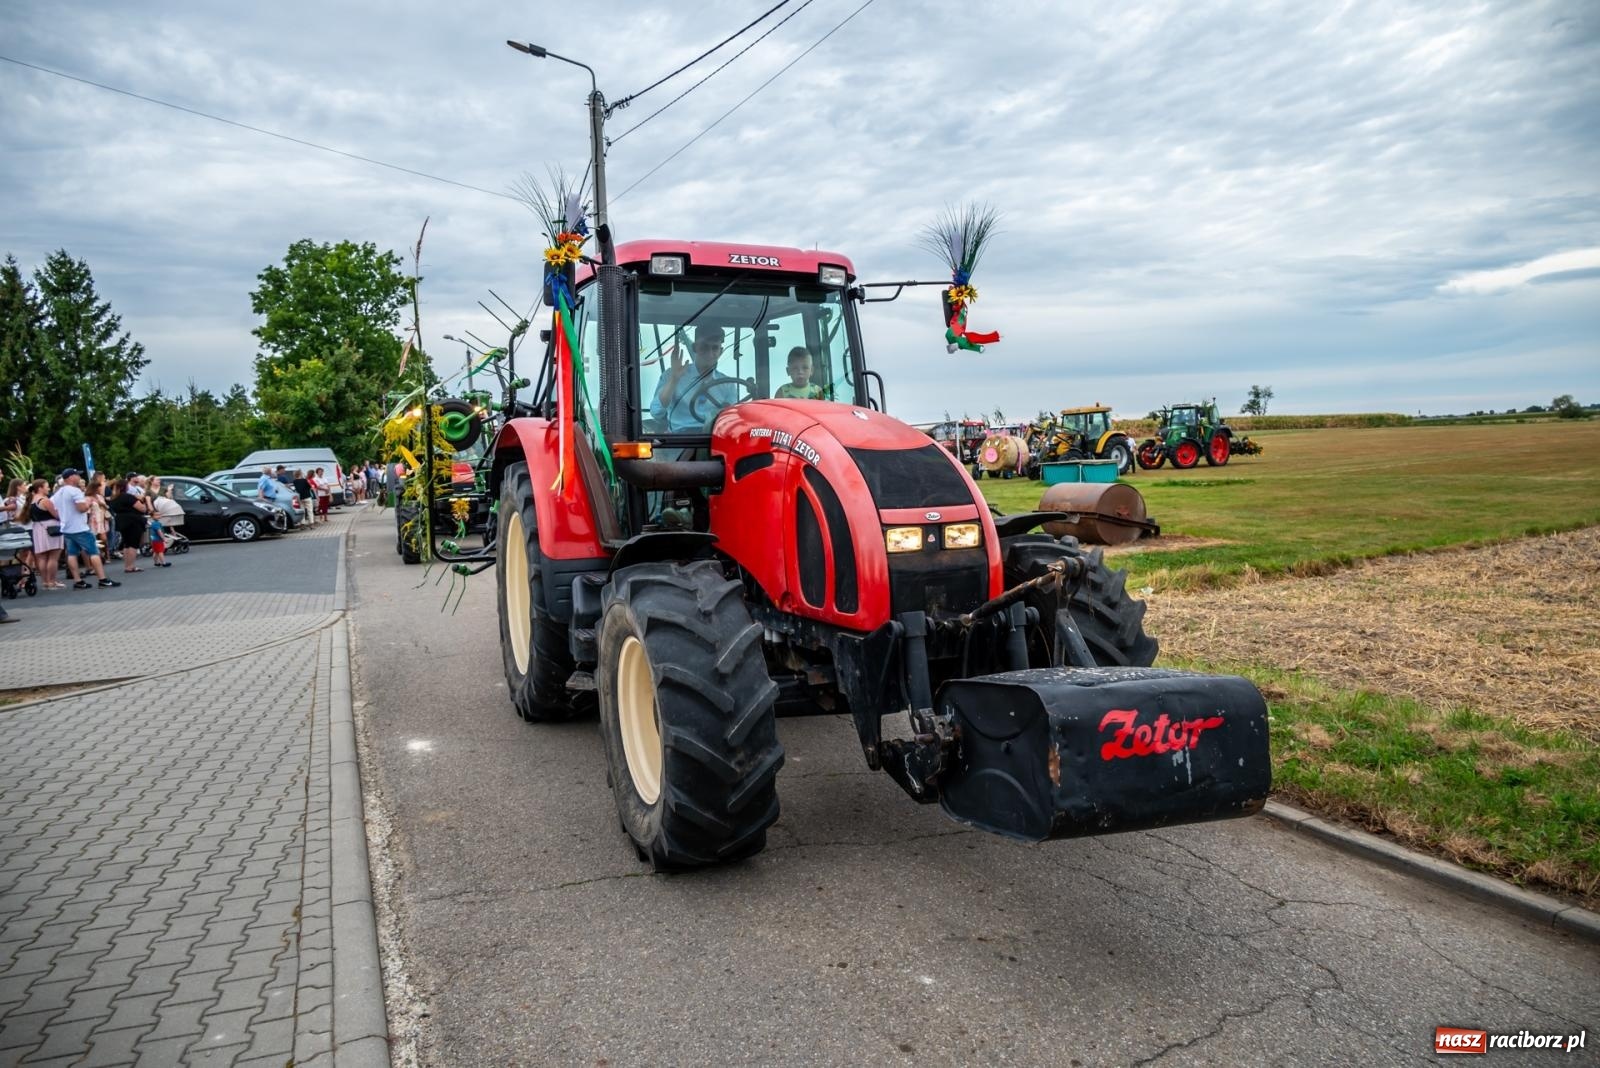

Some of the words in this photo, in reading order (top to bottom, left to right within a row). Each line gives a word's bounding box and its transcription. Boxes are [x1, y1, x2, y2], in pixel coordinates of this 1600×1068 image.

[730, 254, 780, 266] ZETOR
[772, 430, 792, 447] 11741
[794, 439, 821, 466] ZETOR
[1098, 708, 1225, 761] Zetor
